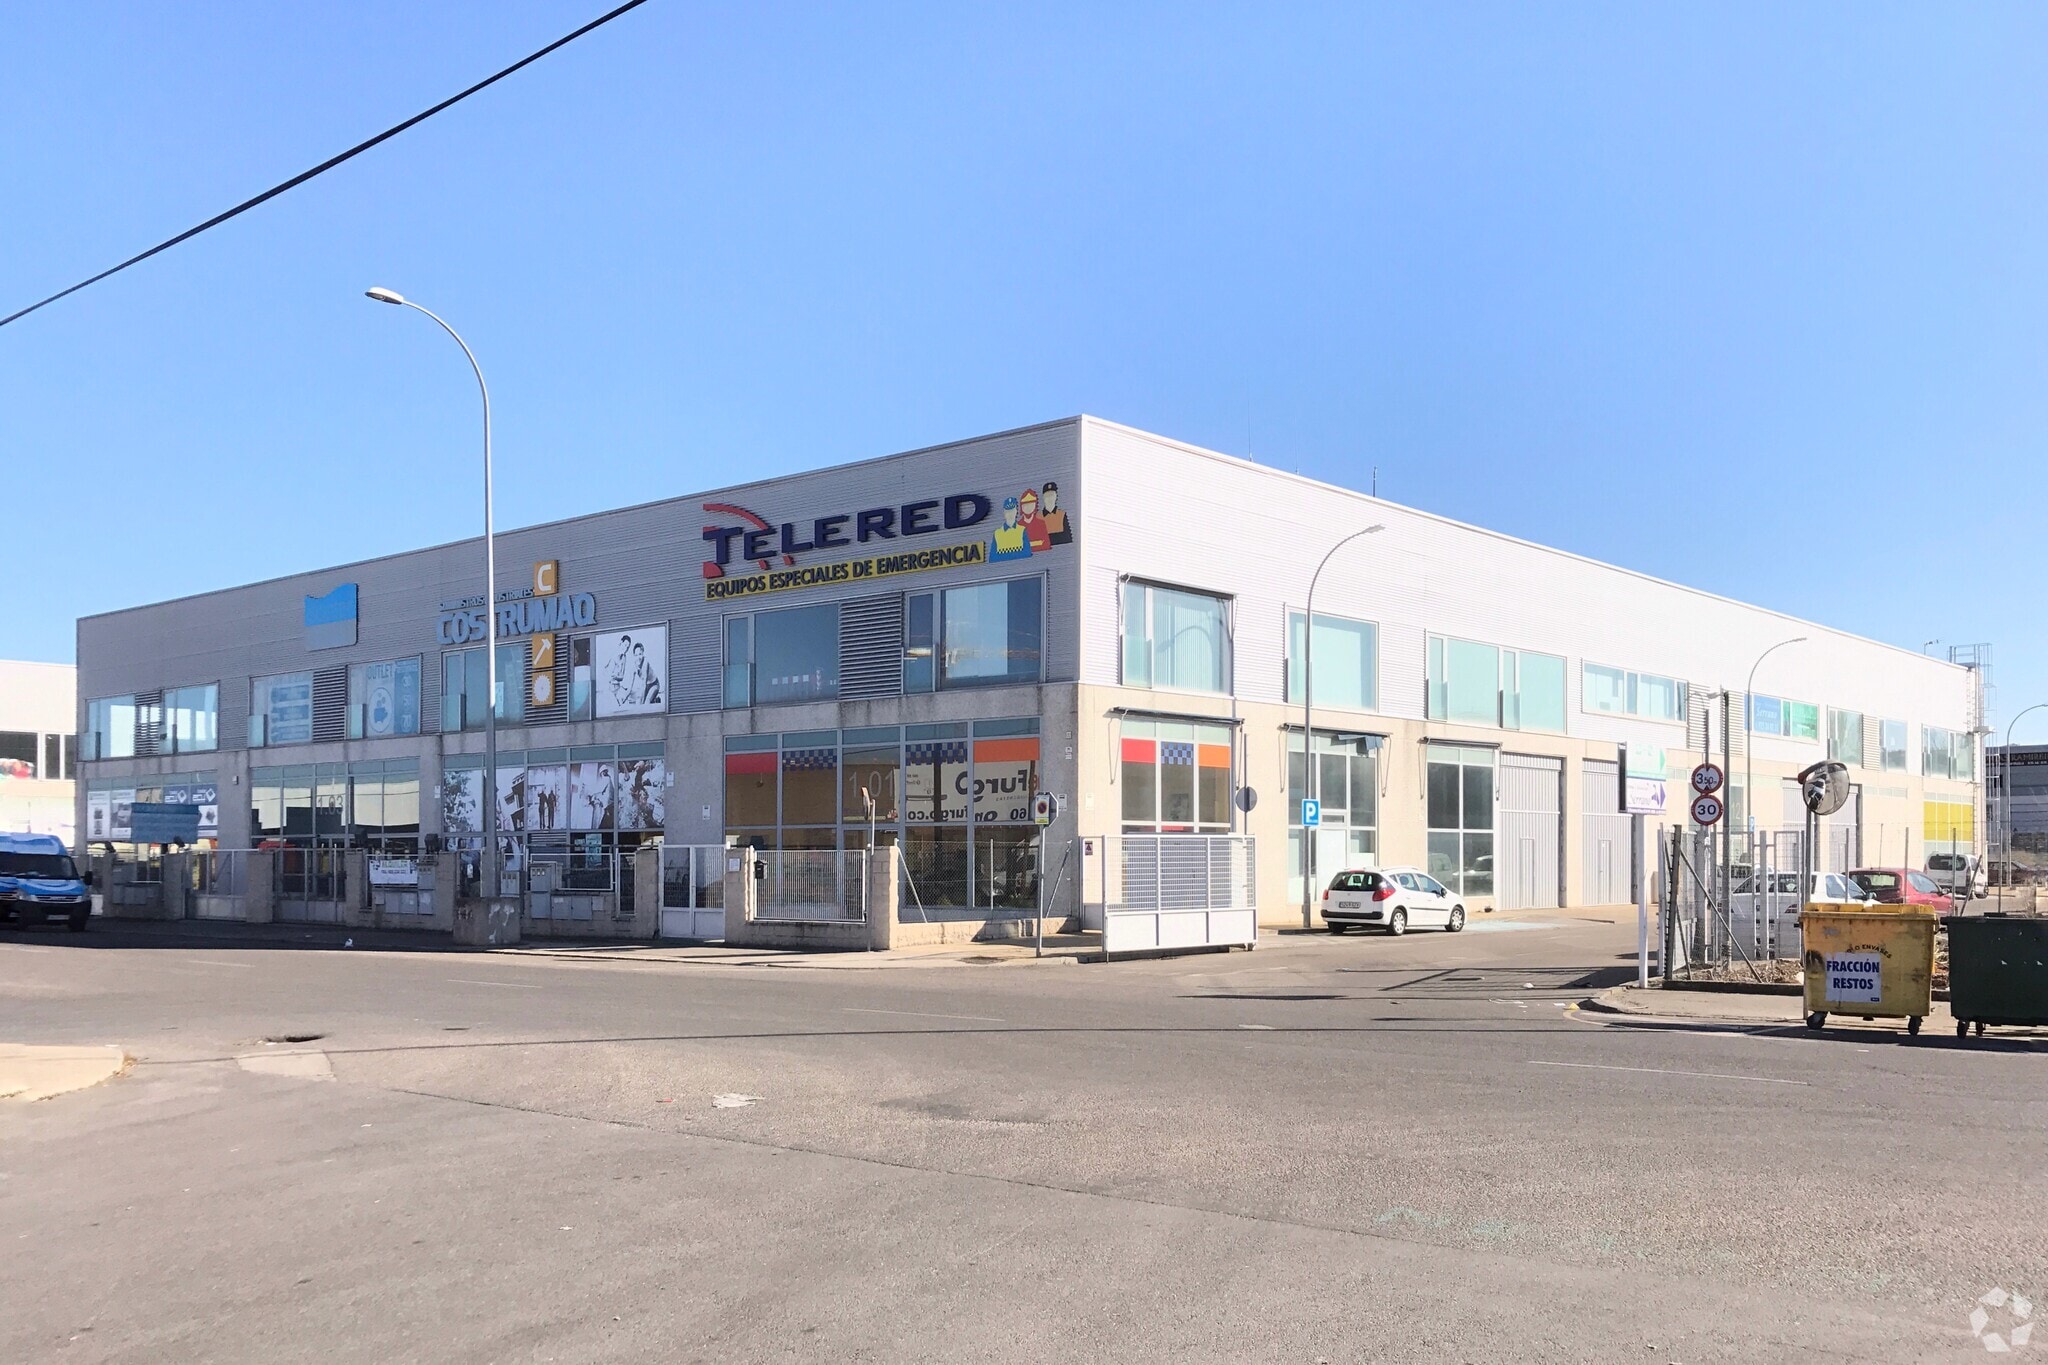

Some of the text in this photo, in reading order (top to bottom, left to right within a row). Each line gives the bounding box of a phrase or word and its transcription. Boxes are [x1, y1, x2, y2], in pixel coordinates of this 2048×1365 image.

[703, 493, 991, 565] TELERED
[537, 563, 551, 591] C
[706, 543, 981, 599] EQUIPOS ESPECIALES DE EMERGENCIA
[1306, 802, 1316, 822] P
[1697, 804, 1717, 816] 30
[1861, 944, 1892, 959] ENVASES
[1826, 958, 1880, 973] FRACCIÓN
[1833, 977, 1874, 990] RESTOS
